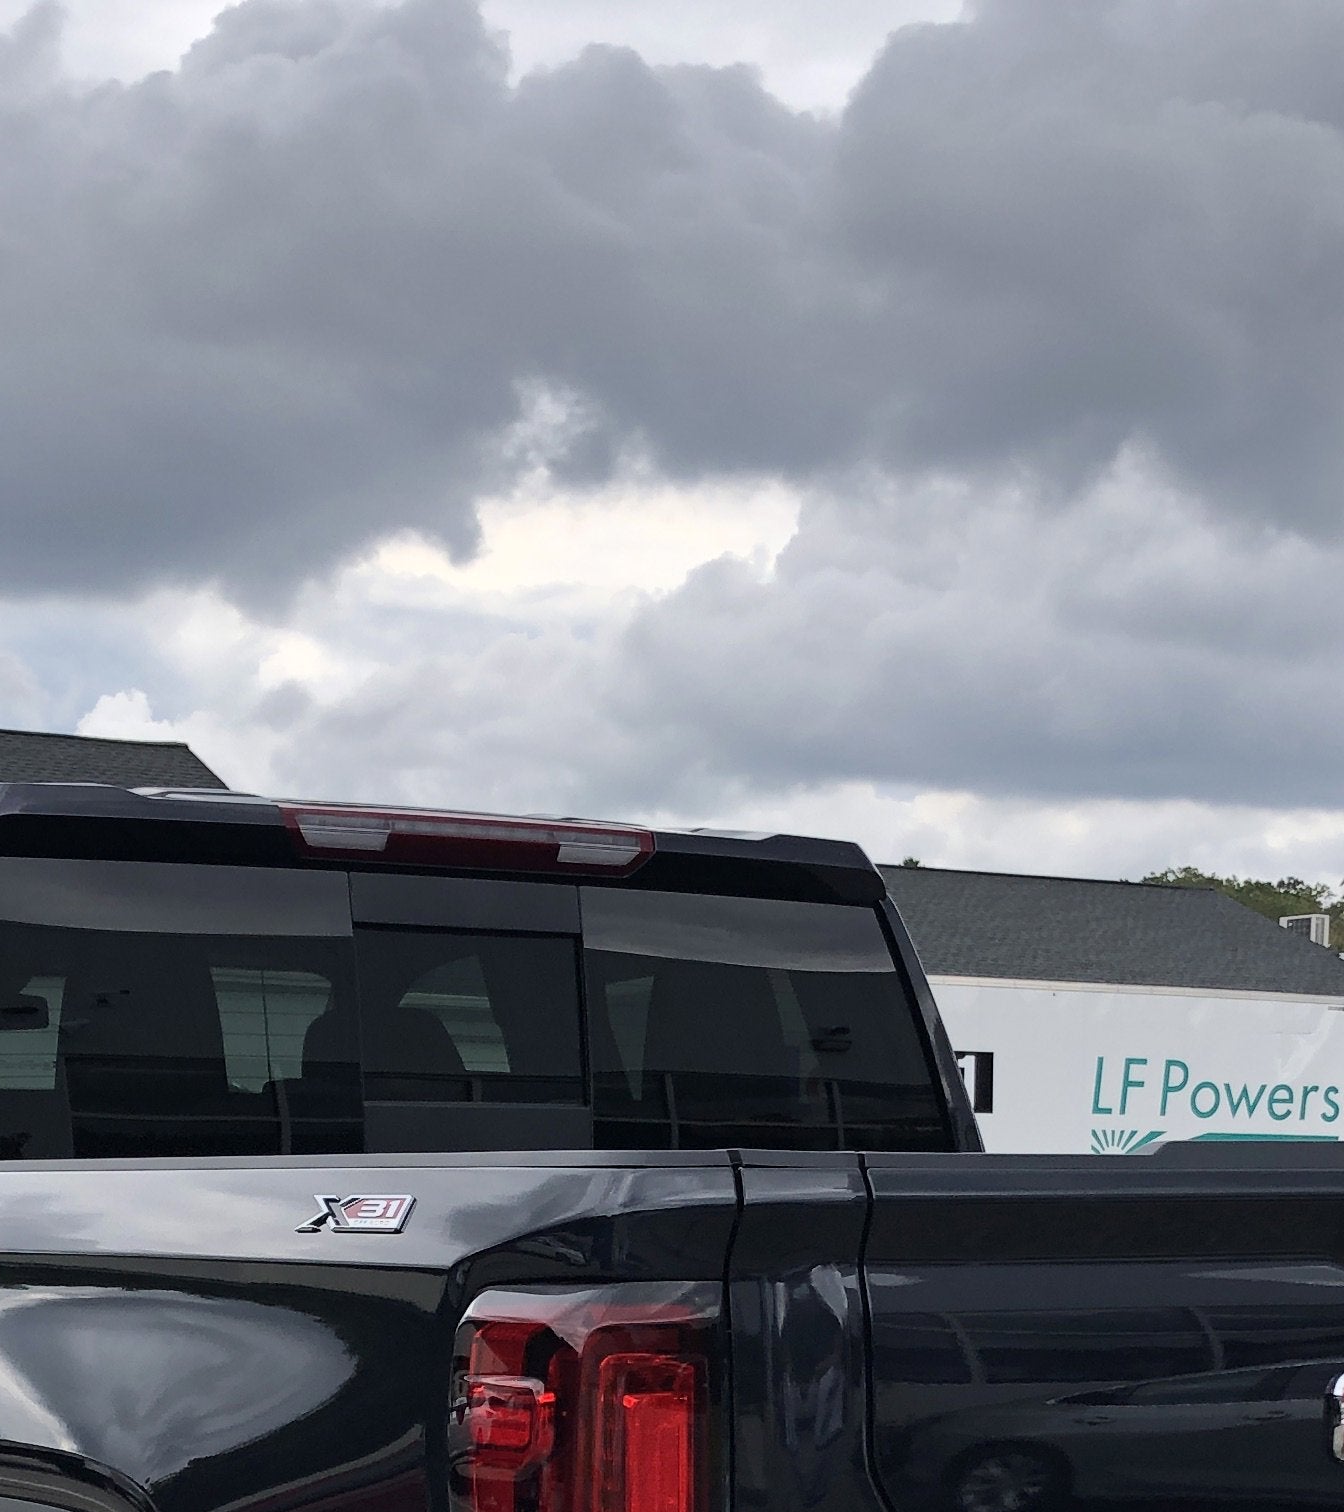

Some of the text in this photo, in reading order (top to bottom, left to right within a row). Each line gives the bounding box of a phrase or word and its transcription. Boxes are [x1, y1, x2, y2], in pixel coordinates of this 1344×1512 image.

[1091, 1056, 1341, 1123] LF Powers
[294, 1193, 416, 1234] X31
